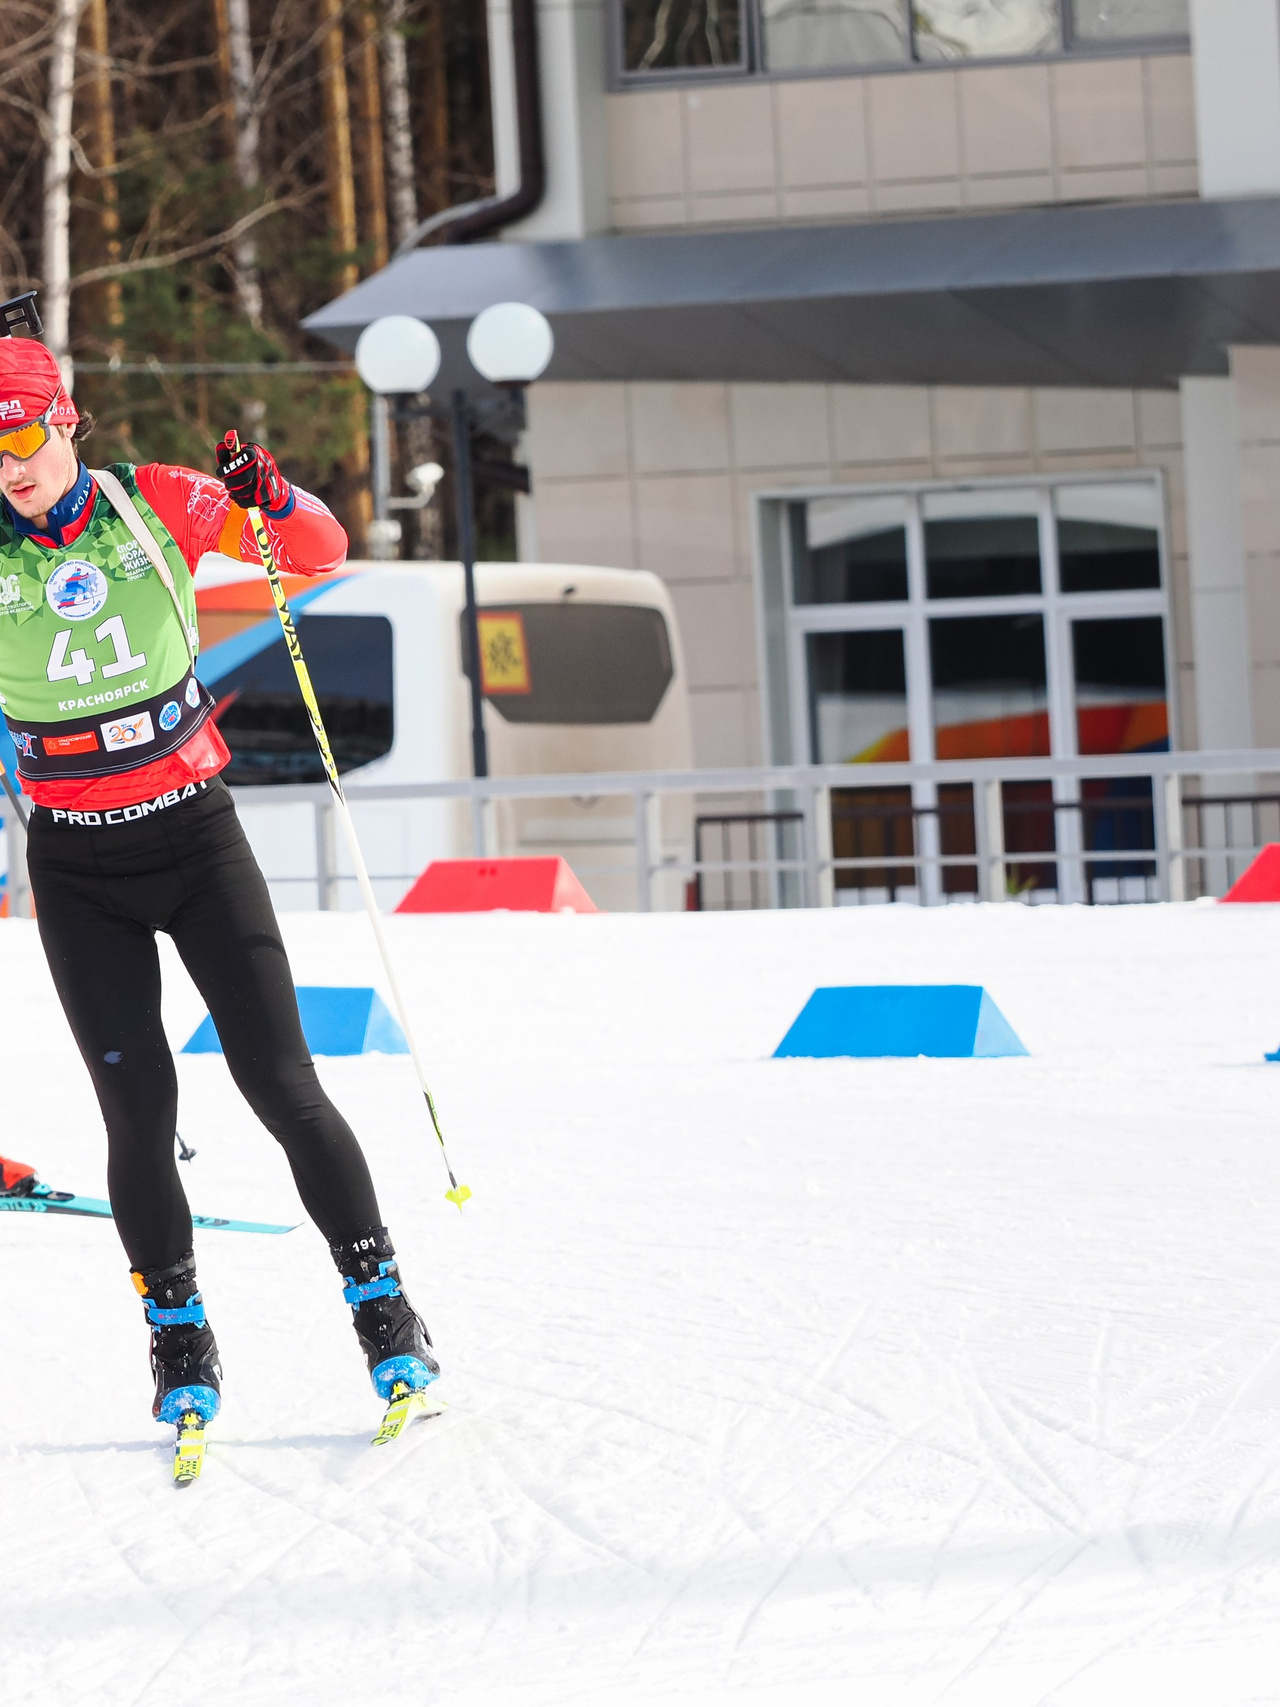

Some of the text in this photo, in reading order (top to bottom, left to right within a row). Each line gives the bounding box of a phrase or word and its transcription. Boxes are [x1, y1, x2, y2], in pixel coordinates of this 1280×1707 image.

[223, 453, 249, 475] LEKI
[116, 539, 138, 554] СПОР
[119, 549, 146, 563] НОРМ
[122, 556, 151, 572] ЖИЗН
[46, 614, 147, 686] 41
[58, 678, 150, 712] КРАСНОЯРСК
[52, 809, 102, 826] PRO
[352, 1236, 377, 1252] 191
